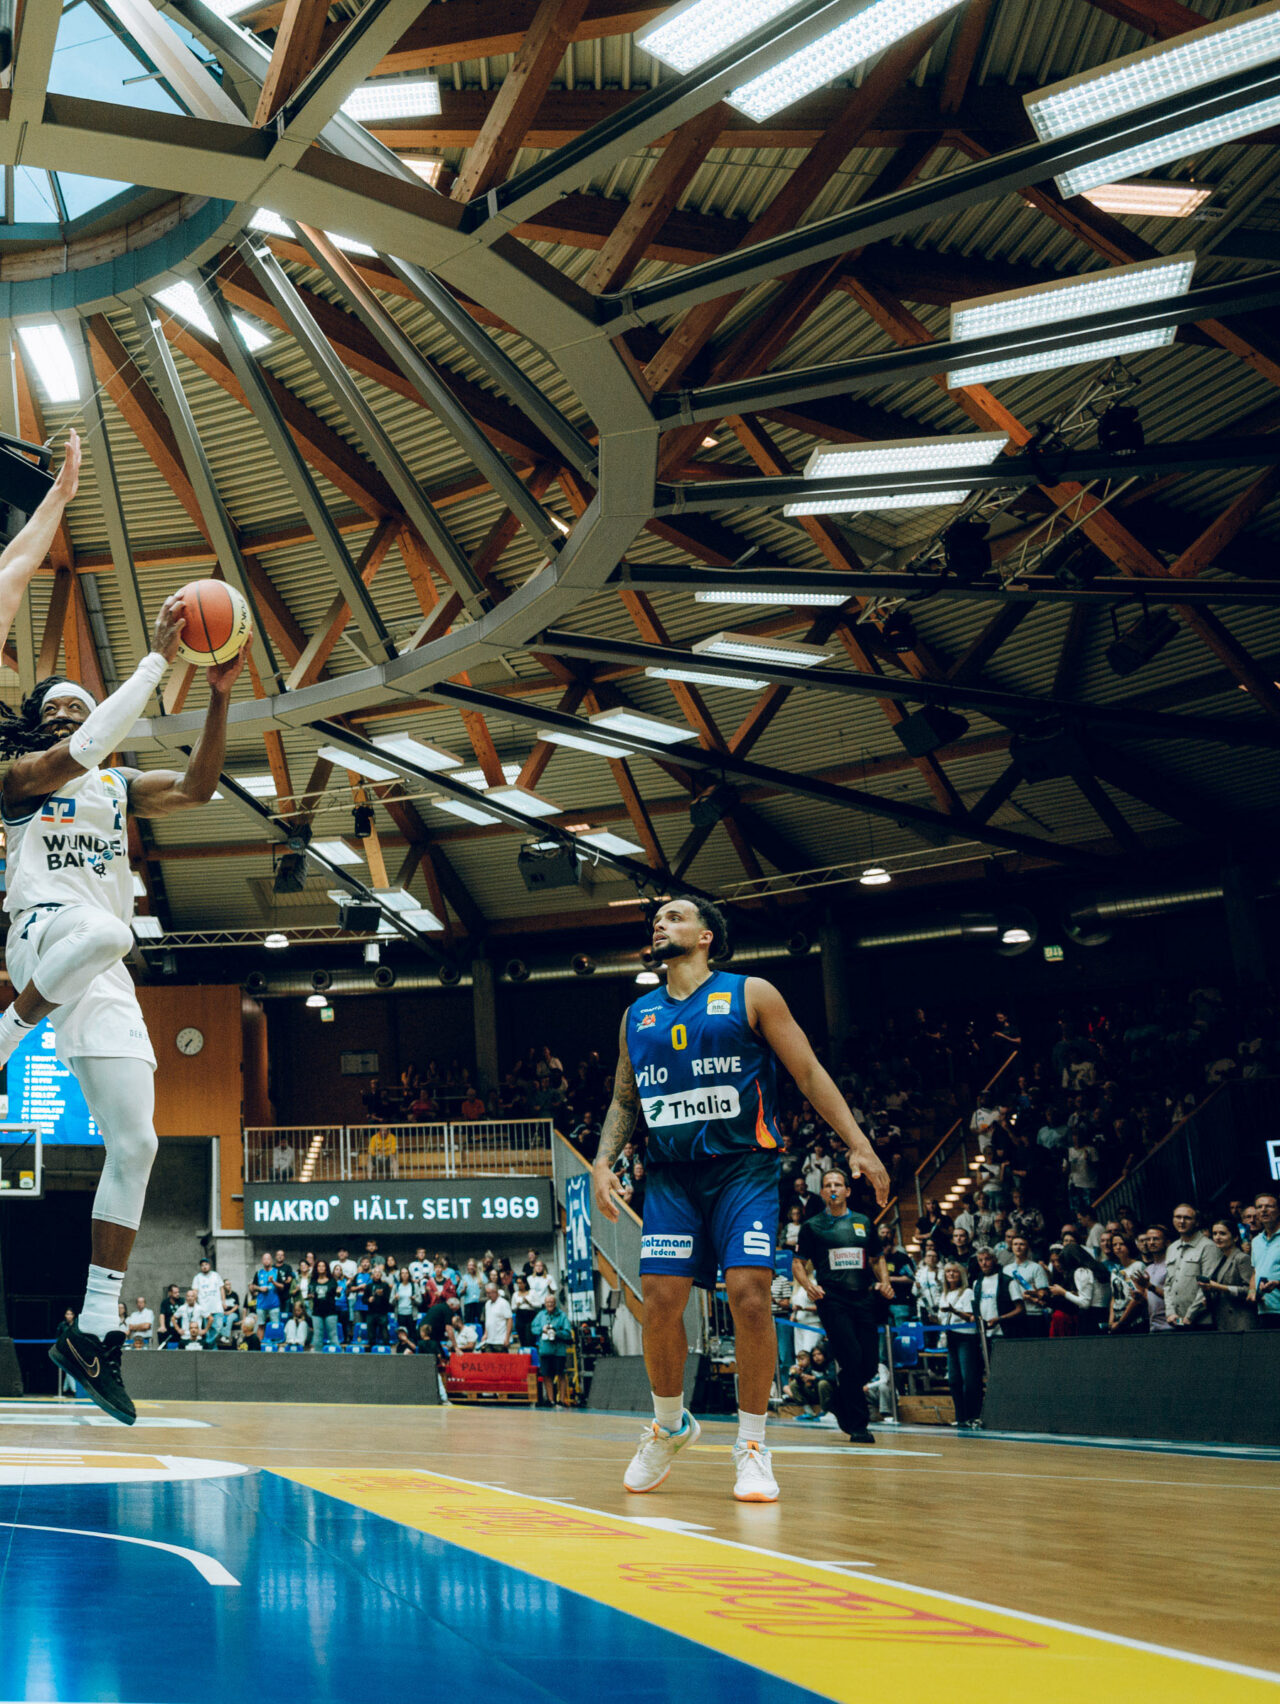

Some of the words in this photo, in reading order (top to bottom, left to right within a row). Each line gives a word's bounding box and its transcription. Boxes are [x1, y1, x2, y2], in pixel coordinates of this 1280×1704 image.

[42, 834, 126, 857] WUNDE
[671, 1024, 688, 1051] 0
[691, 1056, 742, 1077] REWE
[668, 1095, 732, 1119] Thalia
[353, 1195, 415, 1221] HÄLT.
[422, 1197, 472, 1221] SEIT
[481, 1196, 540, 1219] 1969
